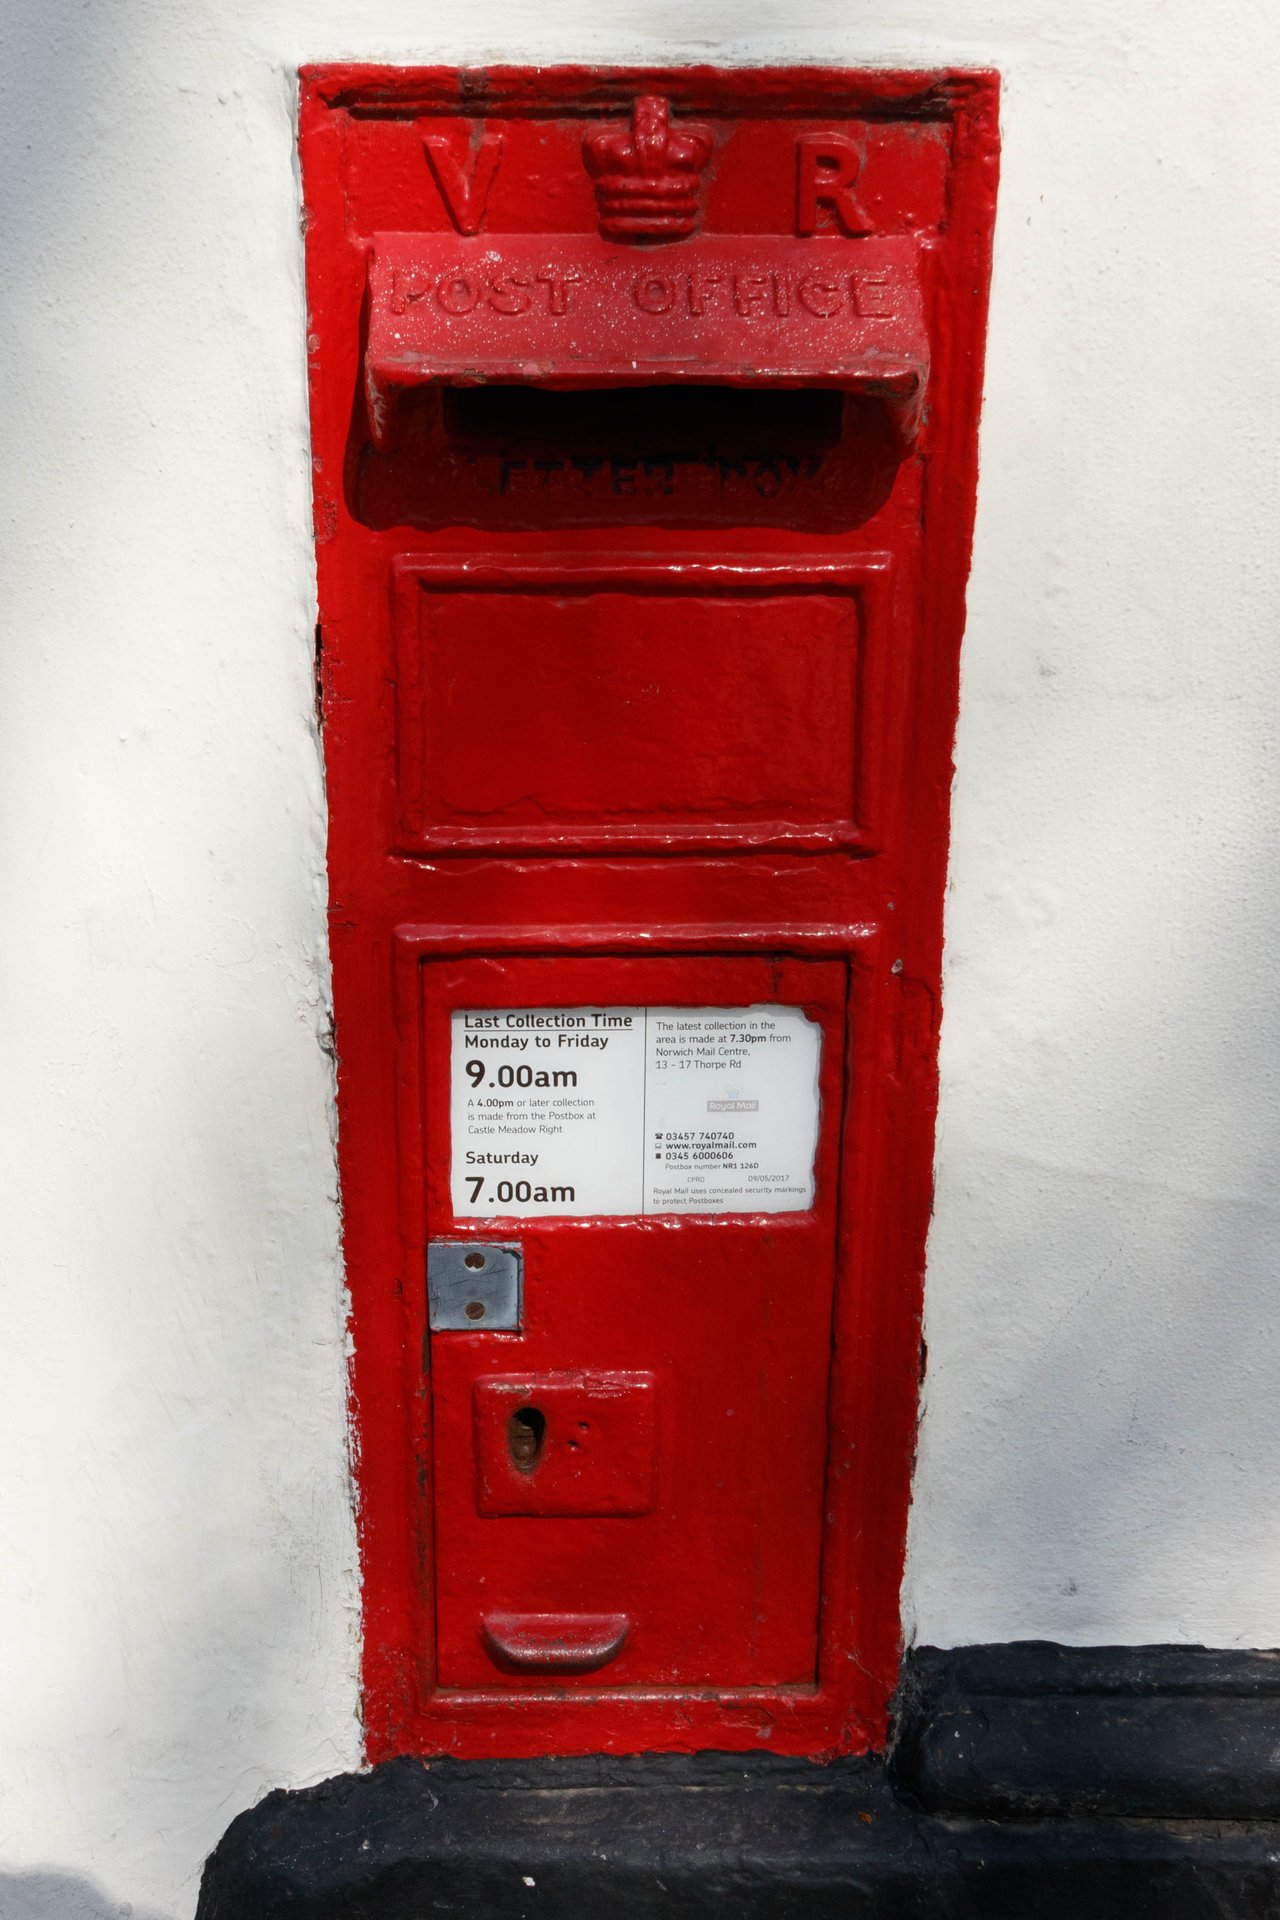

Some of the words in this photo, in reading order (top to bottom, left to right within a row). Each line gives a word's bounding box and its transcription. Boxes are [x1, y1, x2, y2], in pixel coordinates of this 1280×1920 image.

[422, 132, 504, 236] V
[796, 131, 876, 239] R
[389, 272, 581, 318] POST
[632, 273, 896, 321] OFFICE
[464, 1014, 500, 1028] Last
[506, 1014, 586, 1028] Collection
[591, 1014, 633, 1028] Time
[656, 1022, 674, 1031] The
[676, 1021, 701, 1030] latest
[704, 1021, 747, 1030] collection
[749, 1021, 758, 1030] in
[760, 1021, 776, 1030] the
[465, 1035, 529, 1051] Monday
[535, 1036, 551, 1048] to
[558, 1034, 609, 1050] Friday
[655, 1036, 676, 1044] area
[678, 1035, 687, 1043] is
[689, 1035, 715, 1043] made
[718, 1035, 727, 1043] at
[730, 1034, 767, 1044] 7.30pm
[769, 1033, 792, 1042] from
[656, 1047, 694, 1057] Norwich
[696, 1047, 715, 1056] Mail
[718, 1047, 751, 1057] Centre,
[655, 1060, 668, 1069] 13
[679, 1060, 691, 1069] 17
[694, 1060, 727, 1070] Thorpe
[729, 1060, 742, 1069] Rd
[465, 1059, 577, 1088] 9.00am
[467, 1099, 475, 1107] A
[477, 1099, 514, 1109] 4.00pm
[529, 1098, 550, 1107] later
[552, 1098, 595, 1107] collection
[709, 1101, 736, 1110] Royal
[737, 1101, 757, 1110] Mail
[467, 1113, 475, 1121] is
[477, 1113, 504, 1121] made
[506, 1112, 528, 1120] from
[531, 1112, 546, 1120] the
[549, 1111, 585, 1120] Postbox
[586, 1112, 596, 1120] at
[468, 1125, 495, 1134] Castle
[498, 1125, 536, 1134] Meadow
[539, 1125, 563, 1135] Right
[666, 1132, 695, 1141] 03457
[699, 1132, 735, 1140] 740740
[665, 1141, 757, 1151] www.royalmail.com
[465, 1151, 539, 1166] Saturday
[665, 1152, 689, 1160] 0345
[692, 1152, 734, 1160] 6000606
[465, 1176, 575, 1203] 7.00am
[653, 1188, 672, 1196] Royal
[745, 1186, 772, 1194] security
[774, 1186, 807, 1194] markings
[662, 1198, 687, 1206] protect
